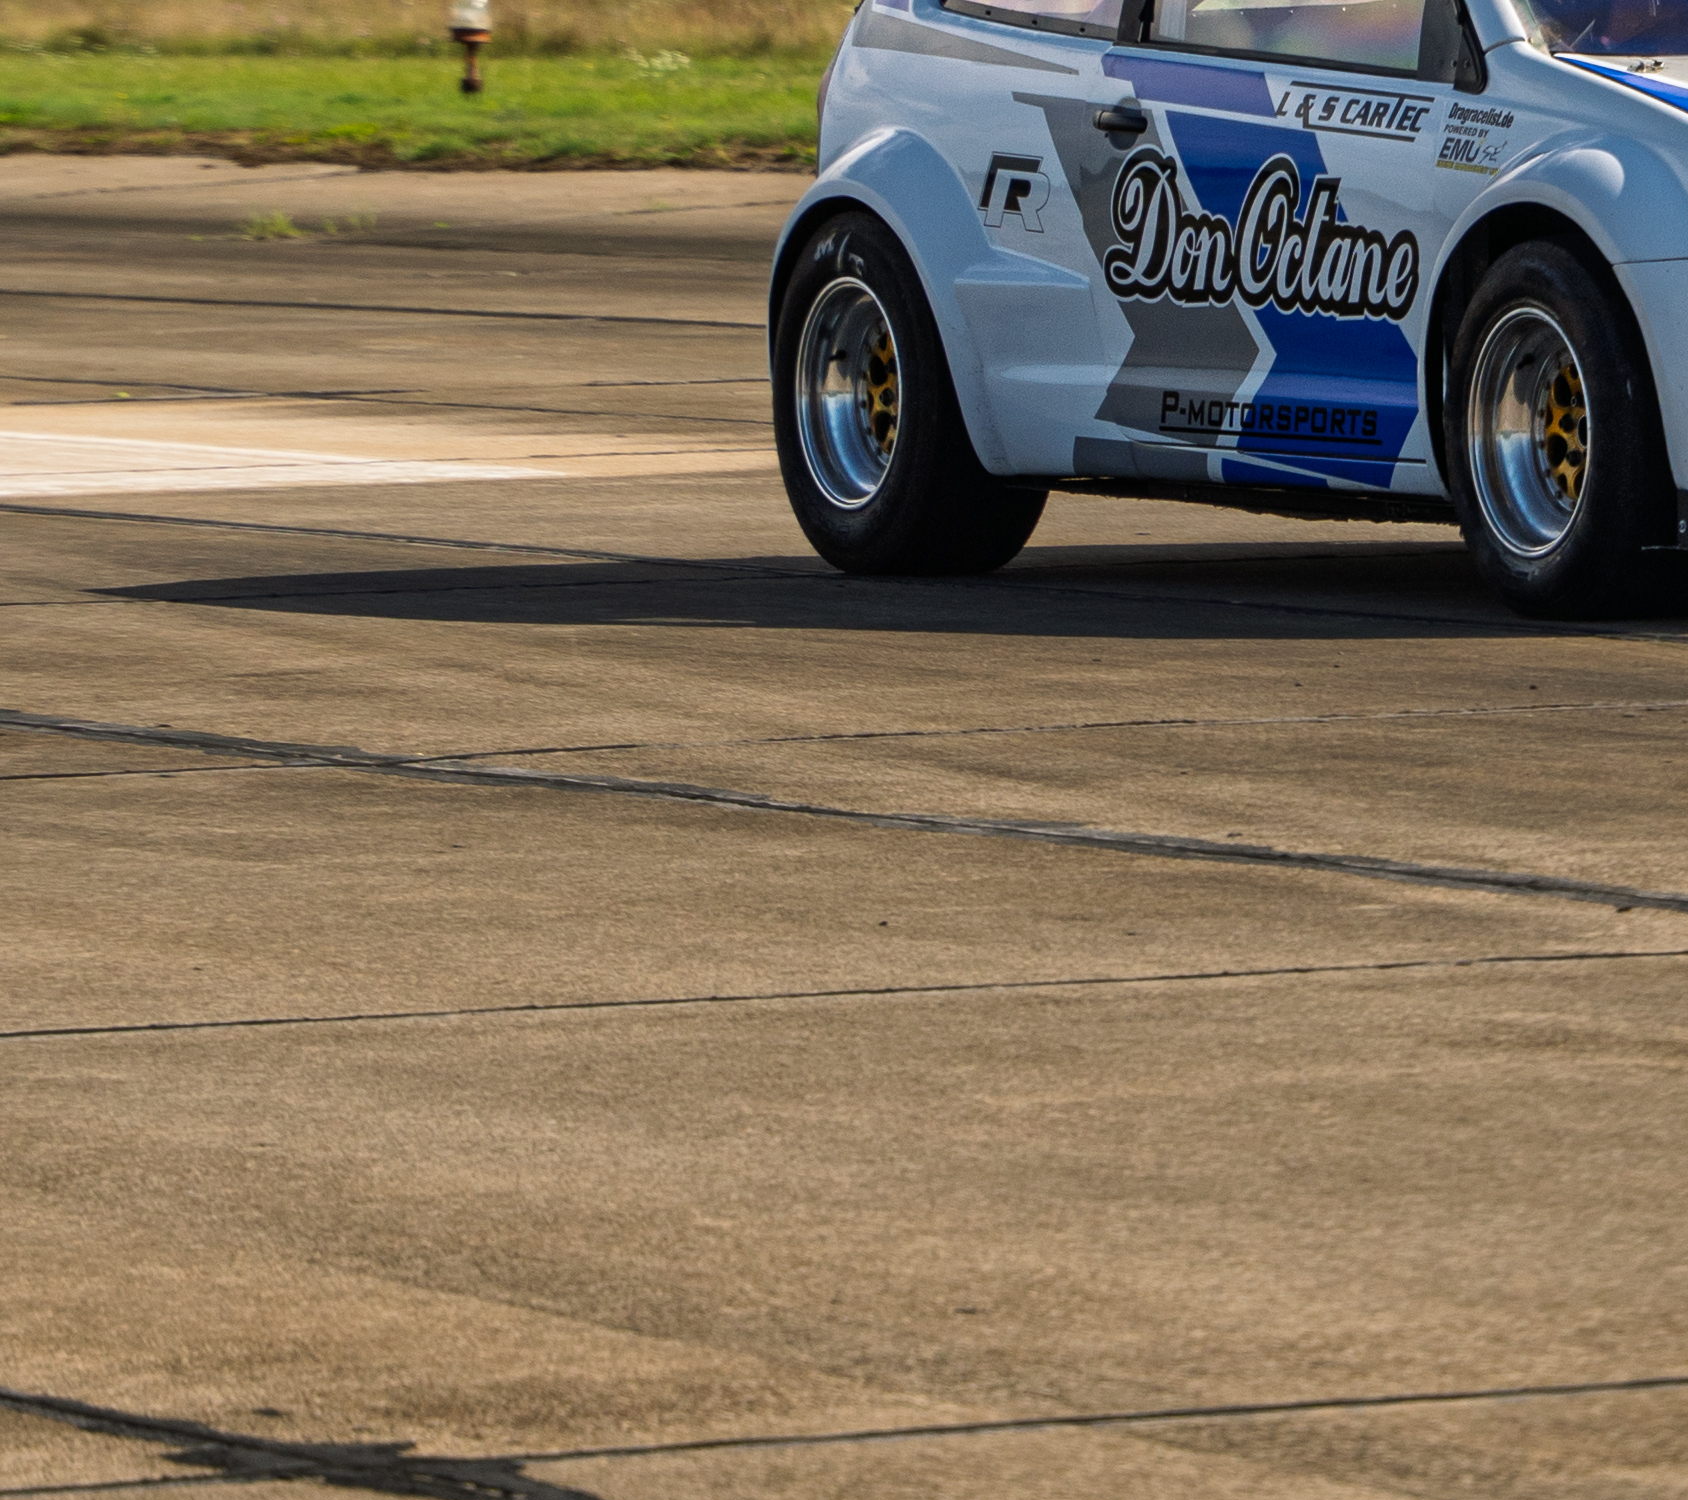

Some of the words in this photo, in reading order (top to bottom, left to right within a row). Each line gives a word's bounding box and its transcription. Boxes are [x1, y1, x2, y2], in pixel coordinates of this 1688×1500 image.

[1277, 91, 1291, 117] L
[1318, 96, 1340, 122] S
[1443, 123, 1478, 137] POWERED
[1477, 128, 1491, 139] BY
[1438, 136, 1482, 164] EMU
[1104, 145, 1236, 306] Don
[1236, 153, 1420, 320] Octane
[1160, 390, 1379, 437] P-MOTORSPORTS
